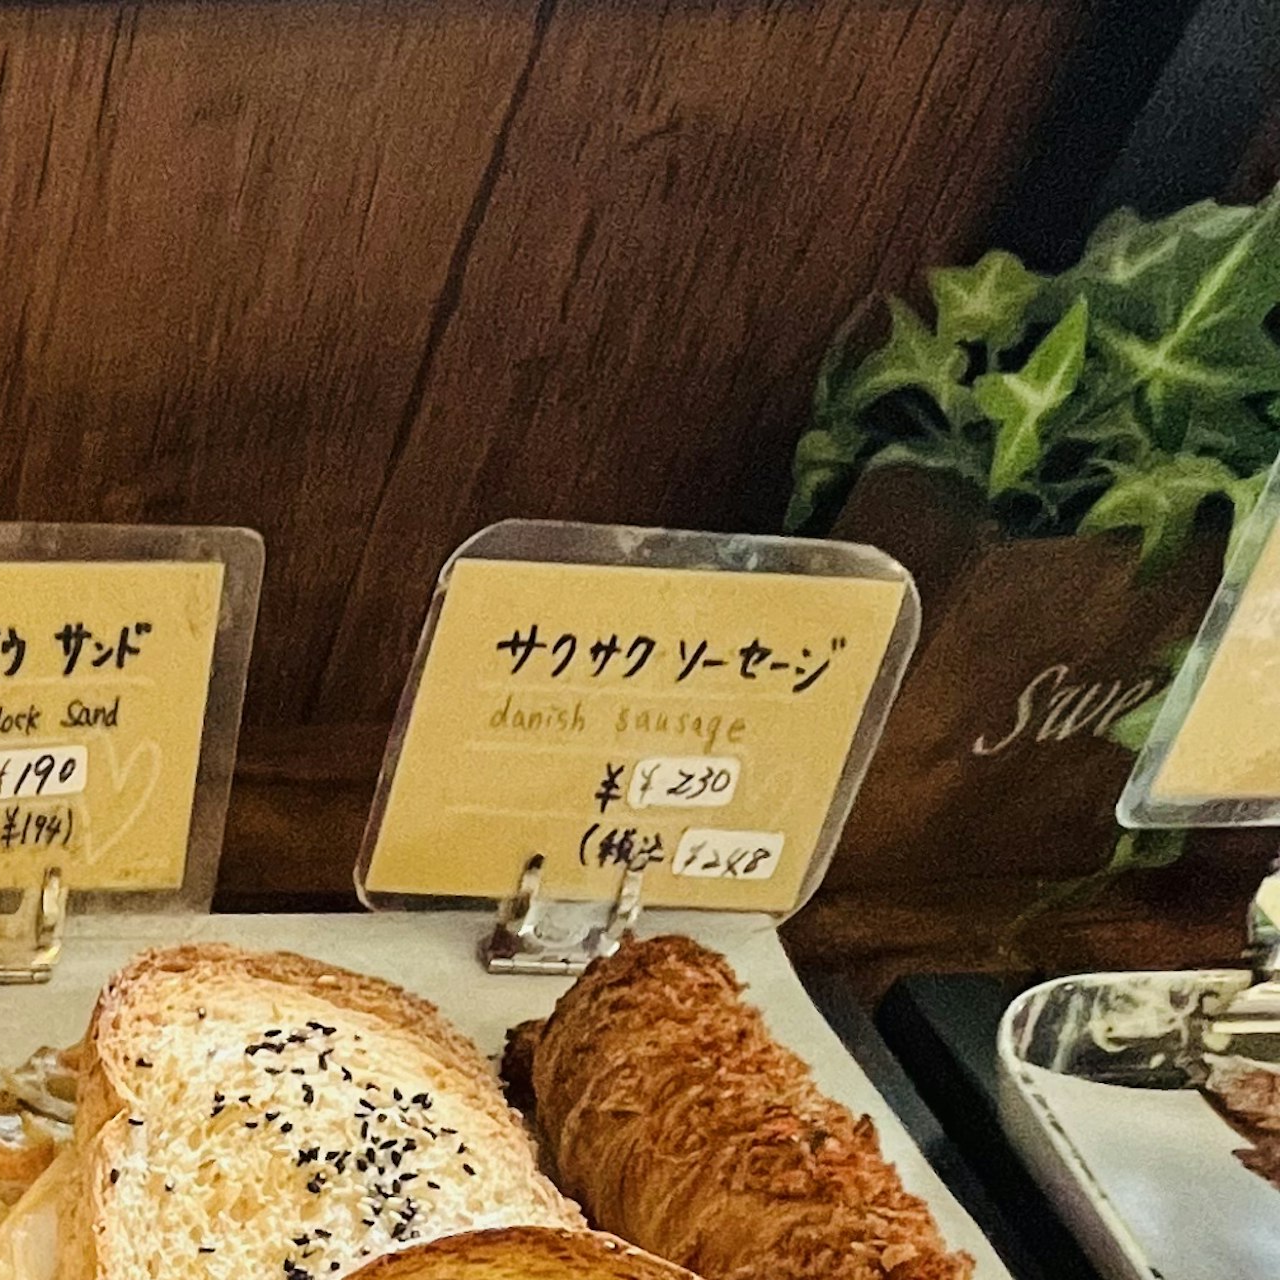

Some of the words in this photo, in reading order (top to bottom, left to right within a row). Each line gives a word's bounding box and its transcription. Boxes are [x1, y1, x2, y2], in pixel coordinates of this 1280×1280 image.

[54, 622, 153, 676] サンド
[496, 624, 657, 678] サクサク
[675, 636, 846, 694] ソーセージ
